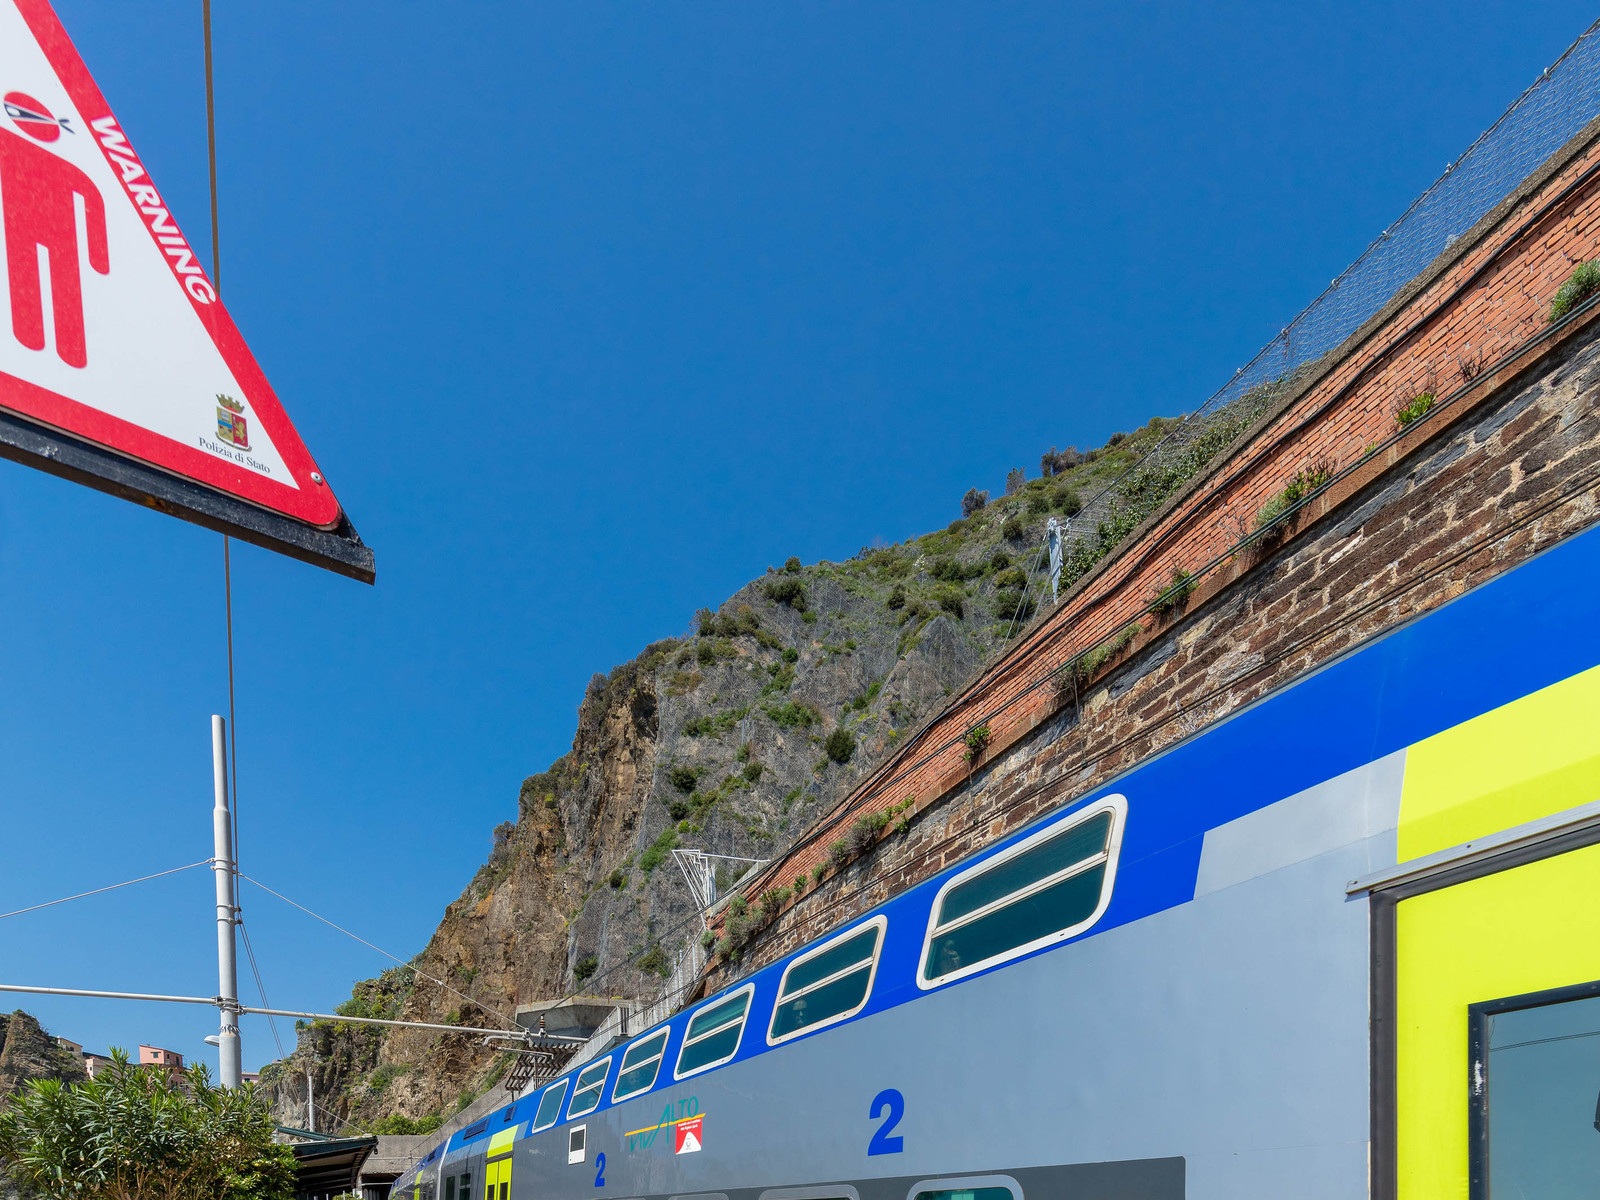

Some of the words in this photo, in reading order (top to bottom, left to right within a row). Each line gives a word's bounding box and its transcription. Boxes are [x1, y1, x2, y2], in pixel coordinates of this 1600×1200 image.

[91, 115, 217, 305] WARNING
[199, 436, 232, 459] Polizia
[234, 452, 244, 463] di
[246, 456, 271, 474] Stato
[867, 1088, 905, 1157] 2
[594, 1152, 606, 1188] 2
